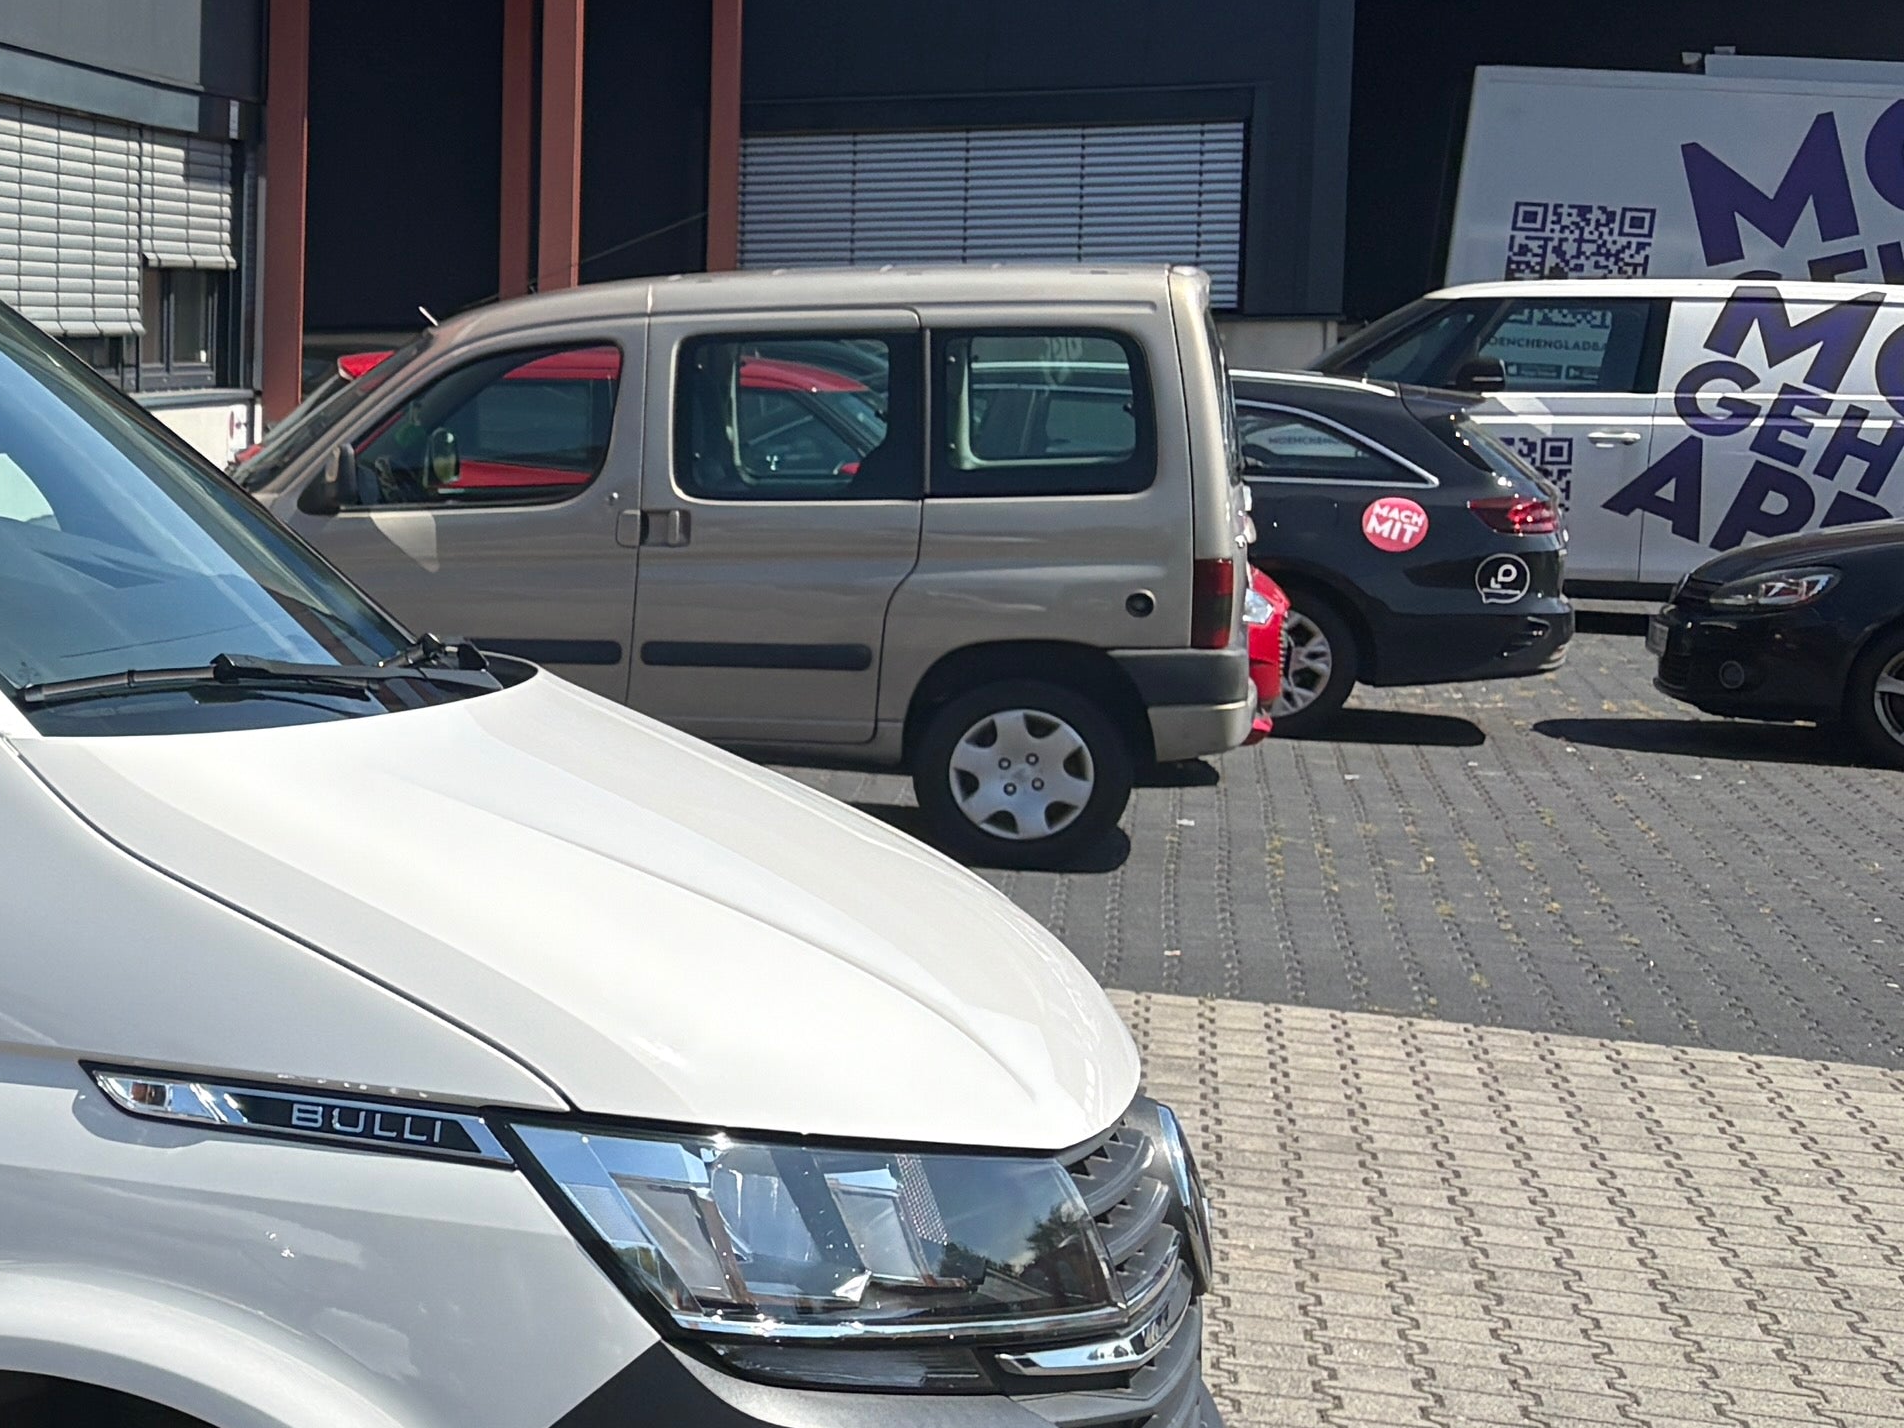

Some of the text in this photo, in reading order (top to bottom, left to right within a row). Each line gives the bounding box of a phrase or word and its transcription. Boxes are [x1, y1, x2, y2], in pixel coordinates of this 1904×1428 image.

[1601, 435, 1894, 552] AP
[1366, 514, 1420, 544] MIT
[1372, 503, 1425, 526] MACH
[291, 1103, 443, 1143] BULLI
